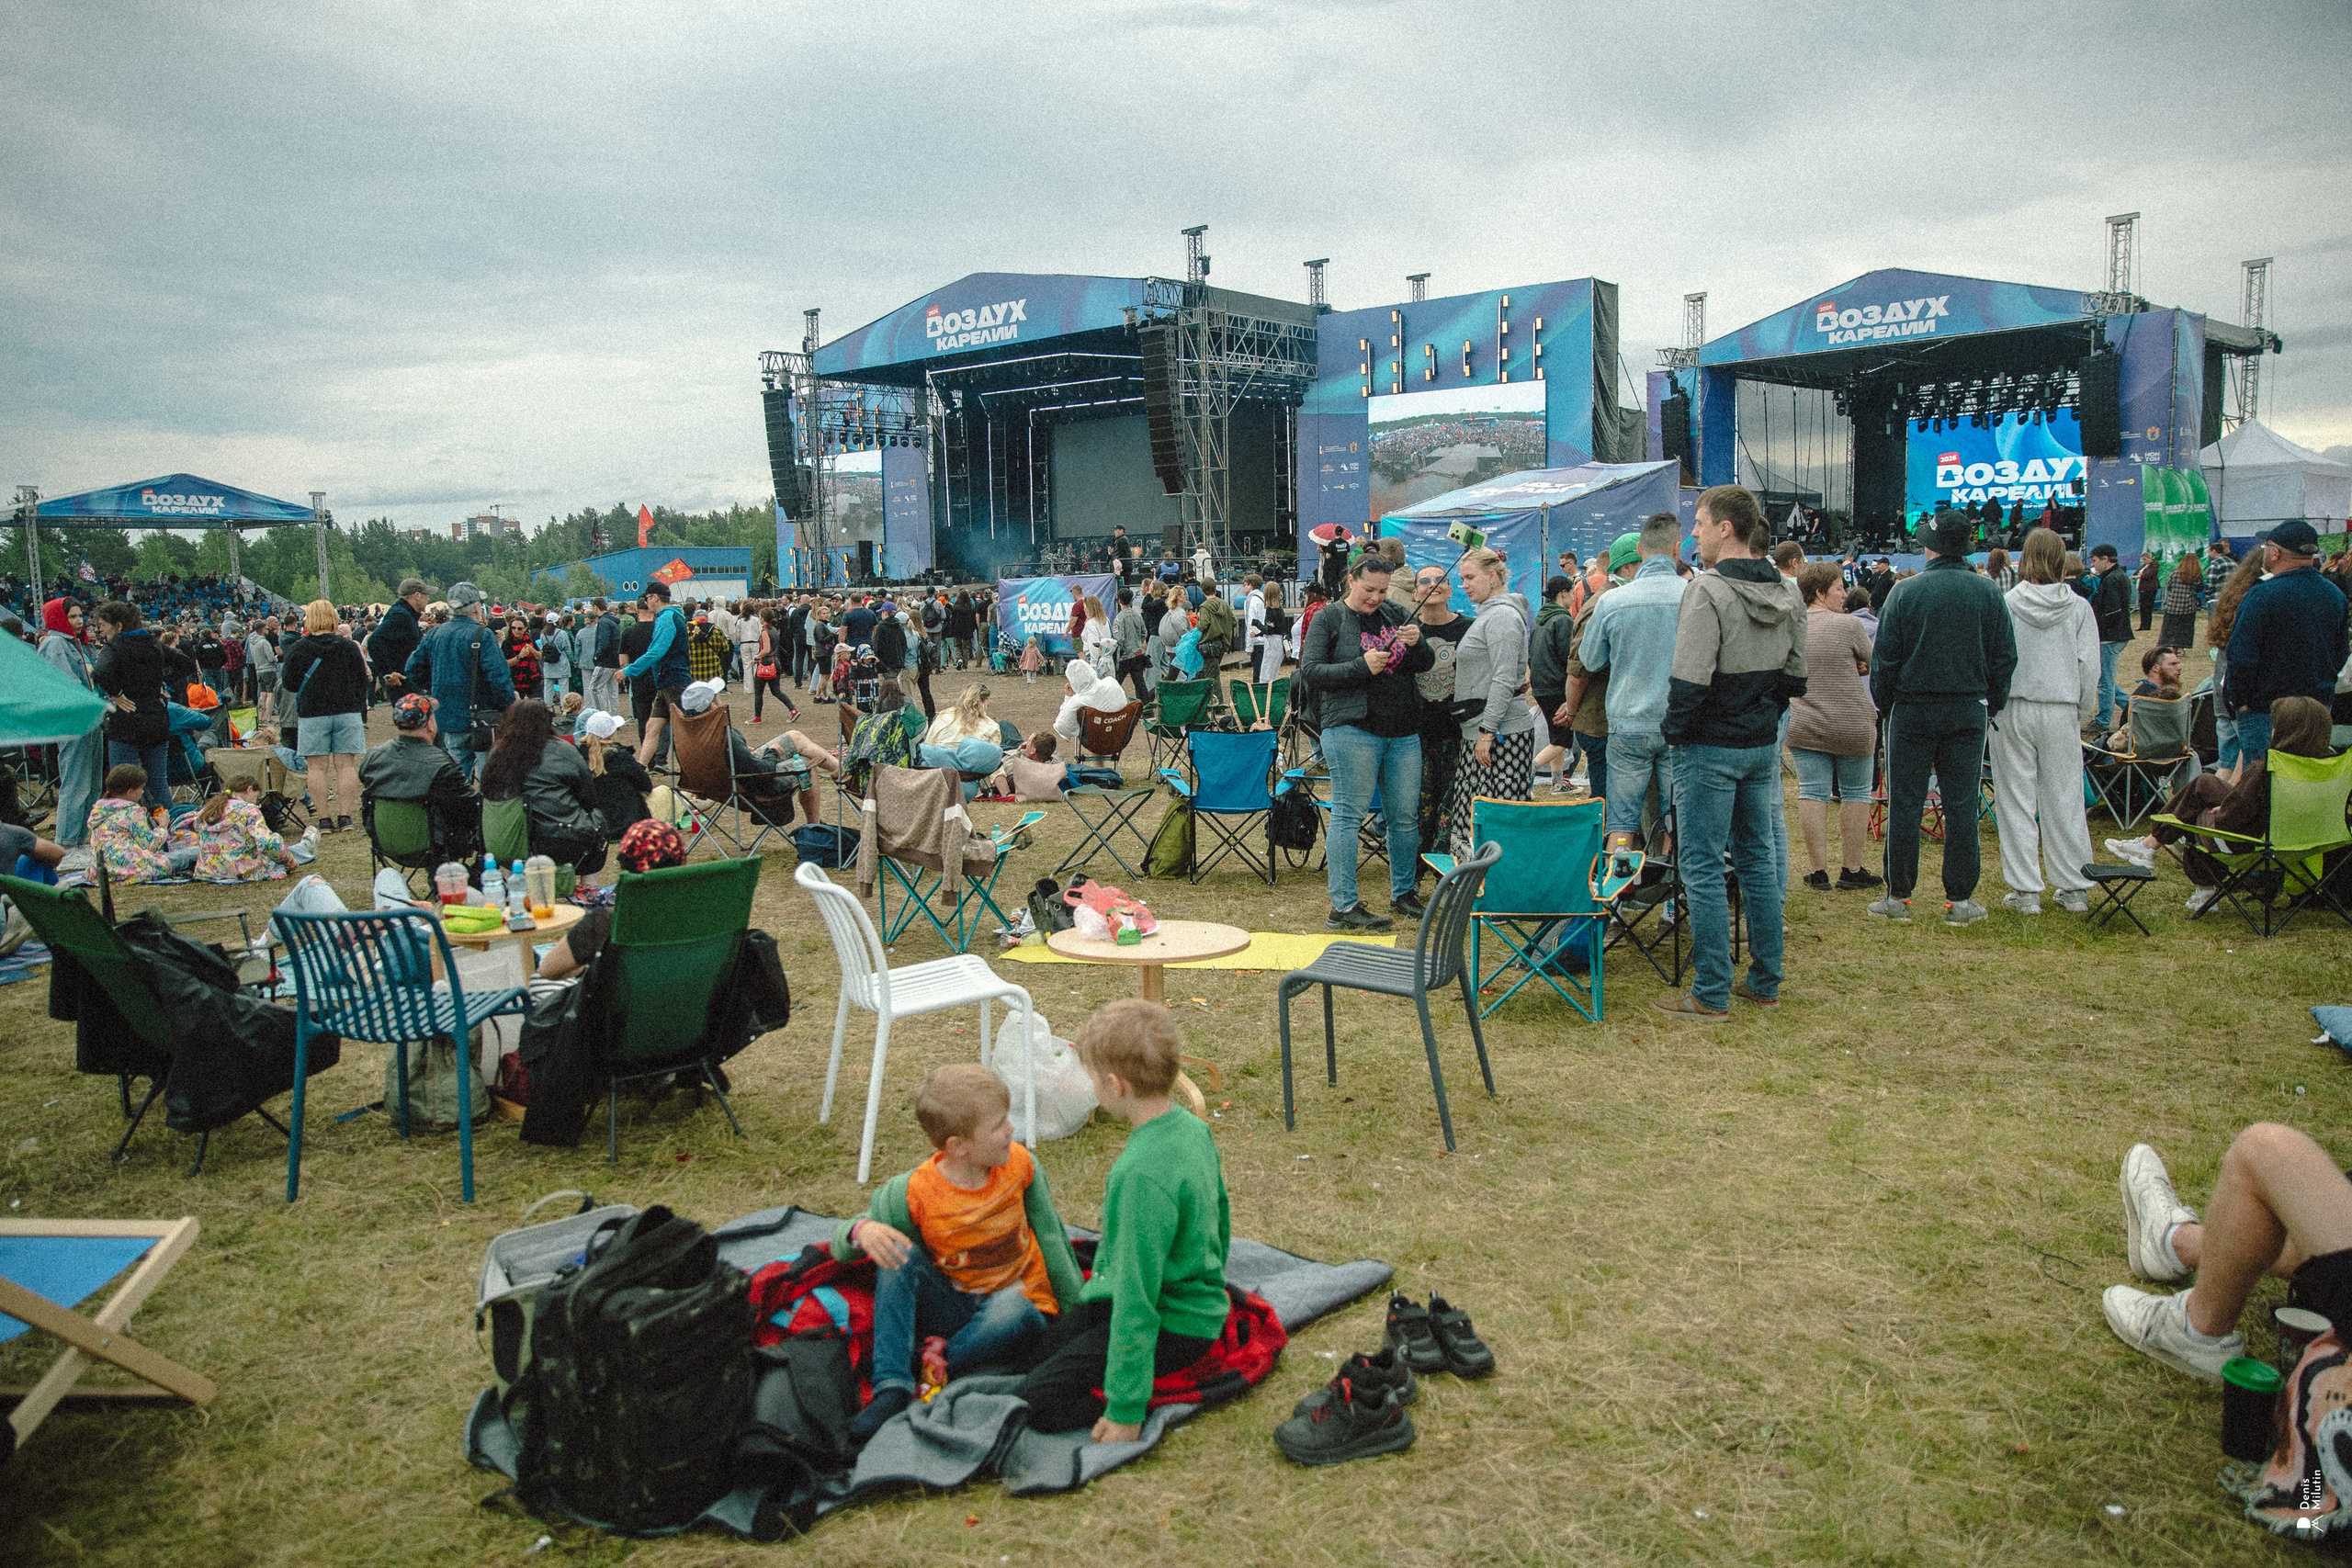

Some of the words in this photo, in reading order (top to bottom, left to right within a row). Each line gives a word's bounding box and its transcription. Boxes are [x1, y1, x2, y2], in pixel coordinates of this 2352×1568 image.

[926, 299, 1027, 338] ВОЗДУХ
[1816, 295, 1951, 333] ВОЗДУХ
[936, 324, 1018, 351] КАРЕЛИИ
[1828, 319, 1936, 344] КАРЕЛИИ
[1940, 455, 1957, 463] 2026
[142, 494, 225, 507] ВОЗДУХ
[152, 506, 220, 514] КАРЕЛИИ
[1018, 602, 1074, 621] ВОЗДУ
[1103, 713, 1127, 724] COACH
